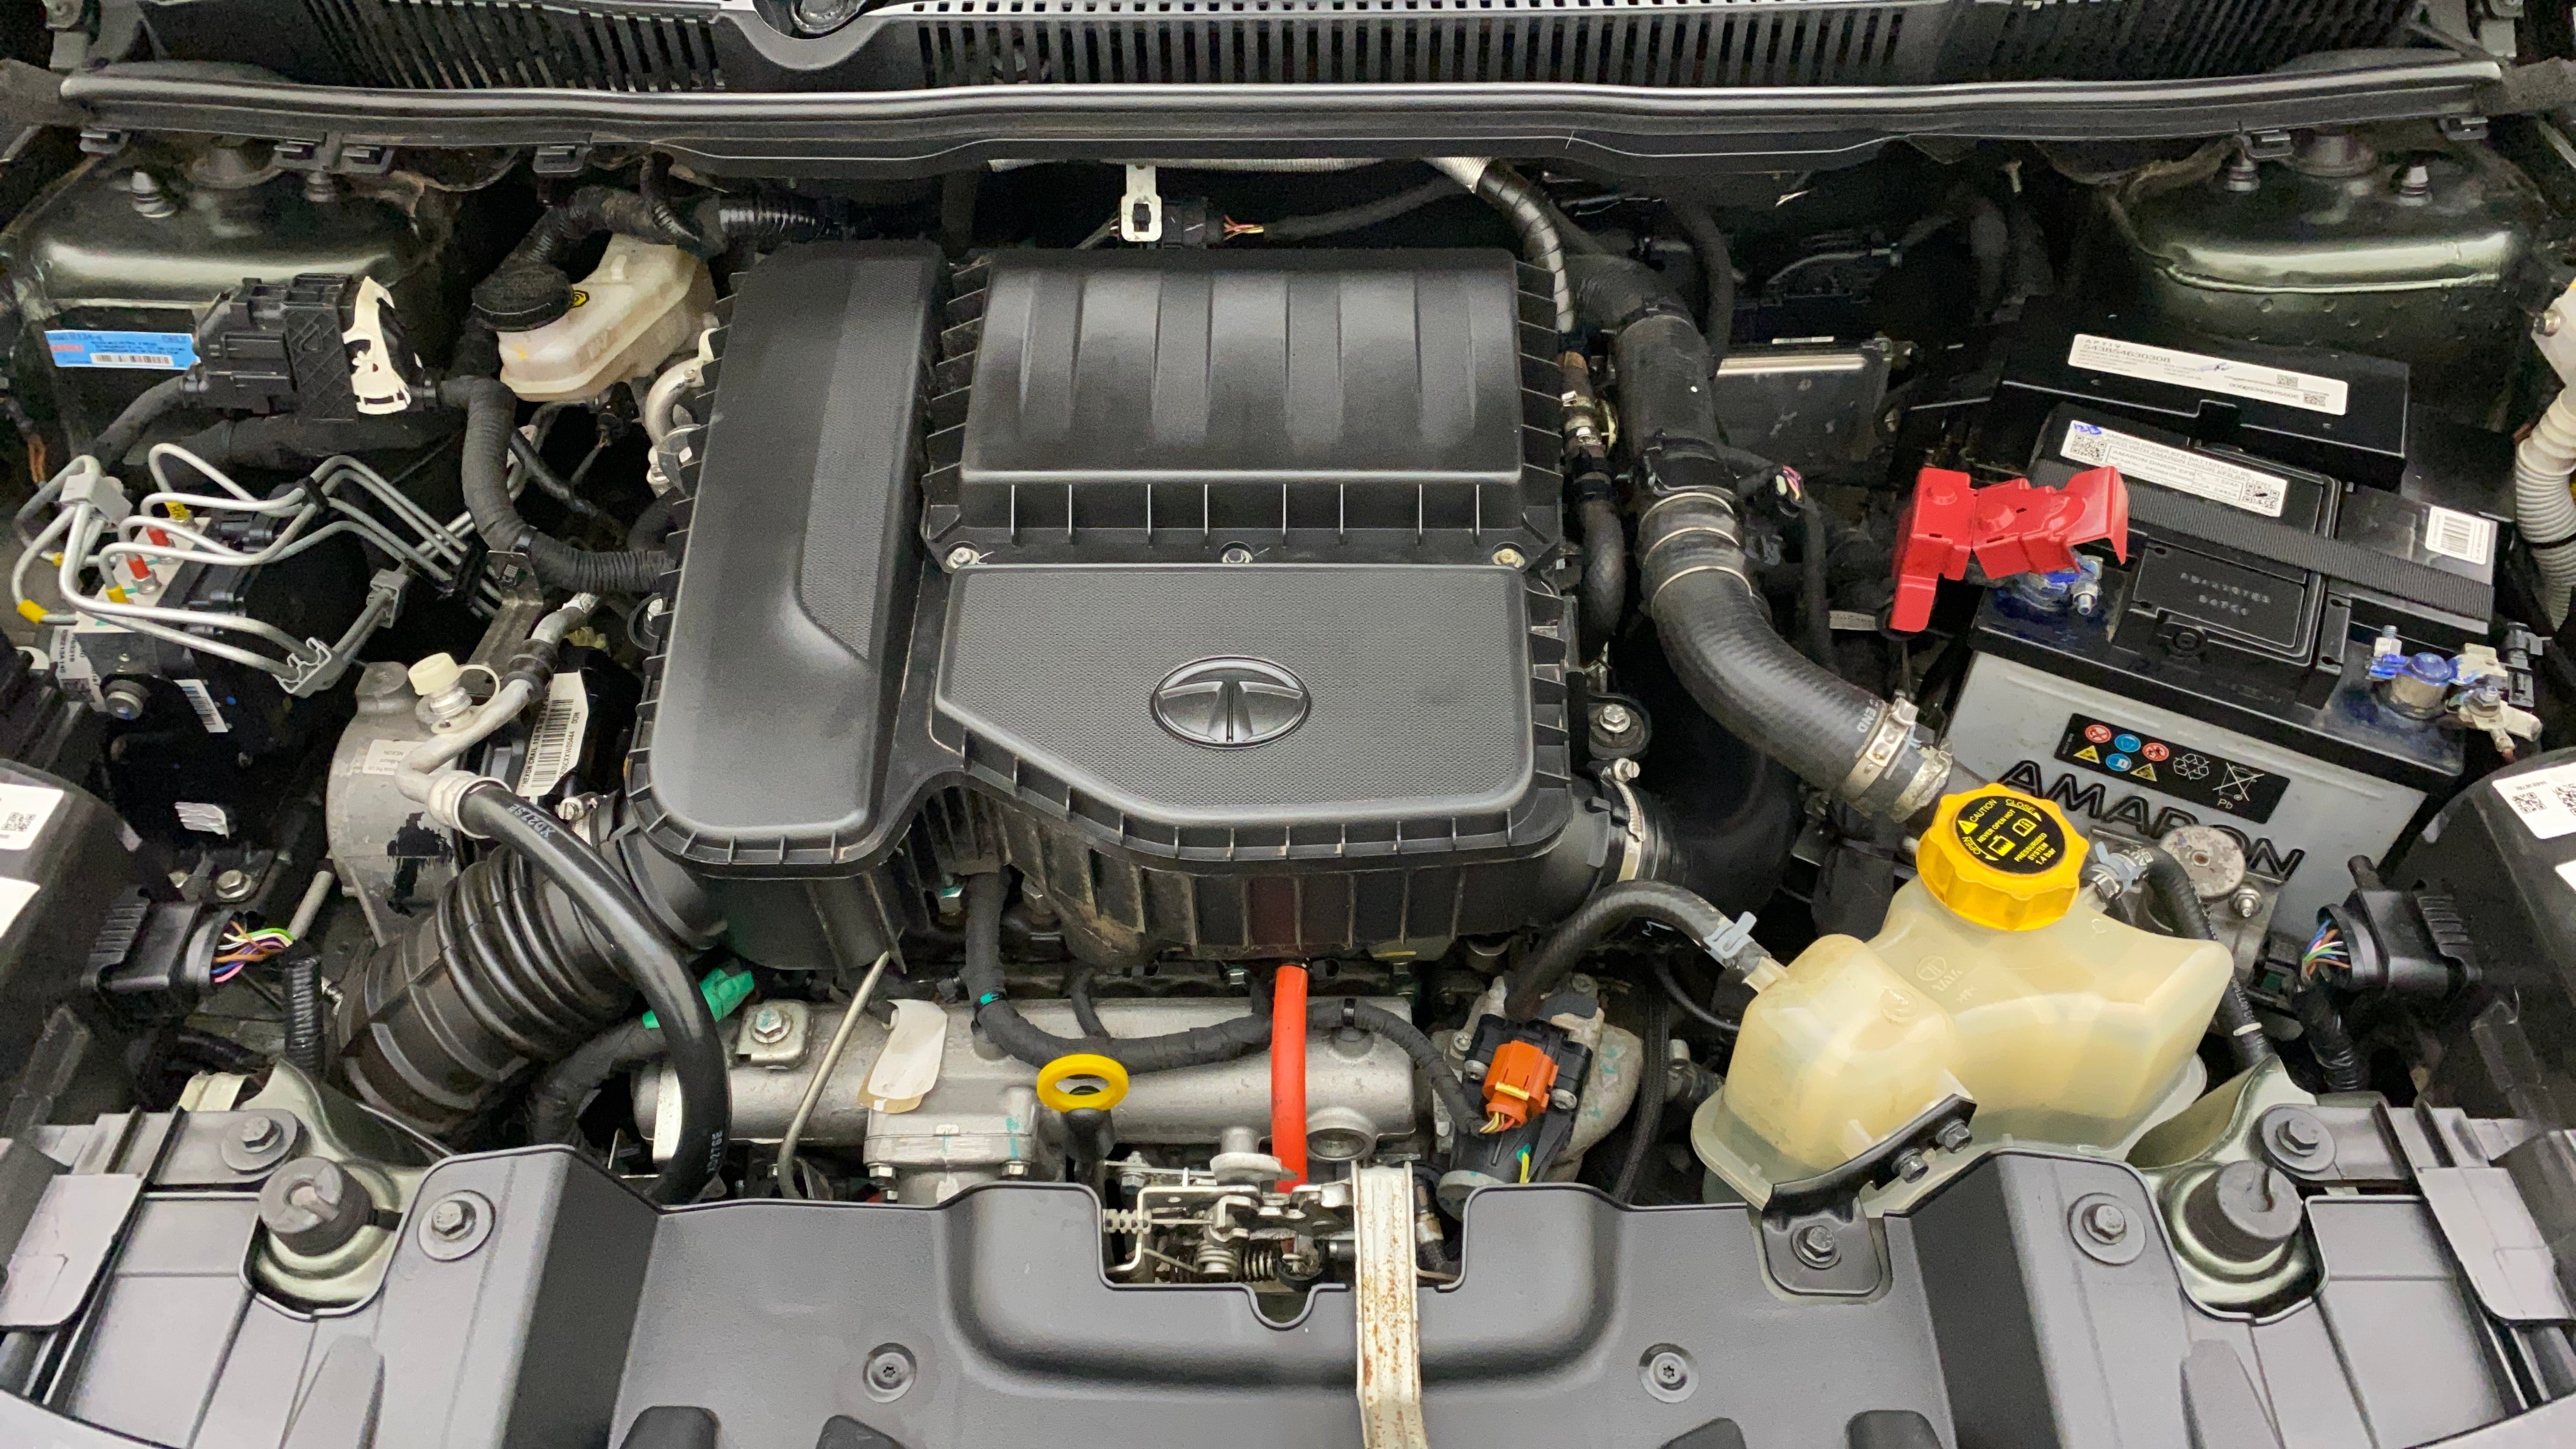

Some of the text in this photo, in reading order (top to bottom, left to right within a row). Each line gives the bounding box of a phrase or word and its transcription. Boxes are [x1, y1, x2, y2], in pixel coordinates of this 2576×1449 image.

[2085, 339, 2122, 348] APTIV
[2113, 449, 2147, 462] AMARON
[2189, 456, 2225, 470] BATTERY
[1857, 706, 1877, 733] END
[1969, 799, 1997, 822] CAUTION
[2005, 799, 2036, 814] CLOSE
[2217, 798, 2233, 809] Pb
[1977, 809, 2016, 843] NEVER OPEN HOT
[1962, 836, 1981, 855] OPEN
[2014, 832, 2047, 862] PRESSURISED
[2028, 842, 2048, 861] SYSTEM
[2044, 848, 2056, 859] bar
